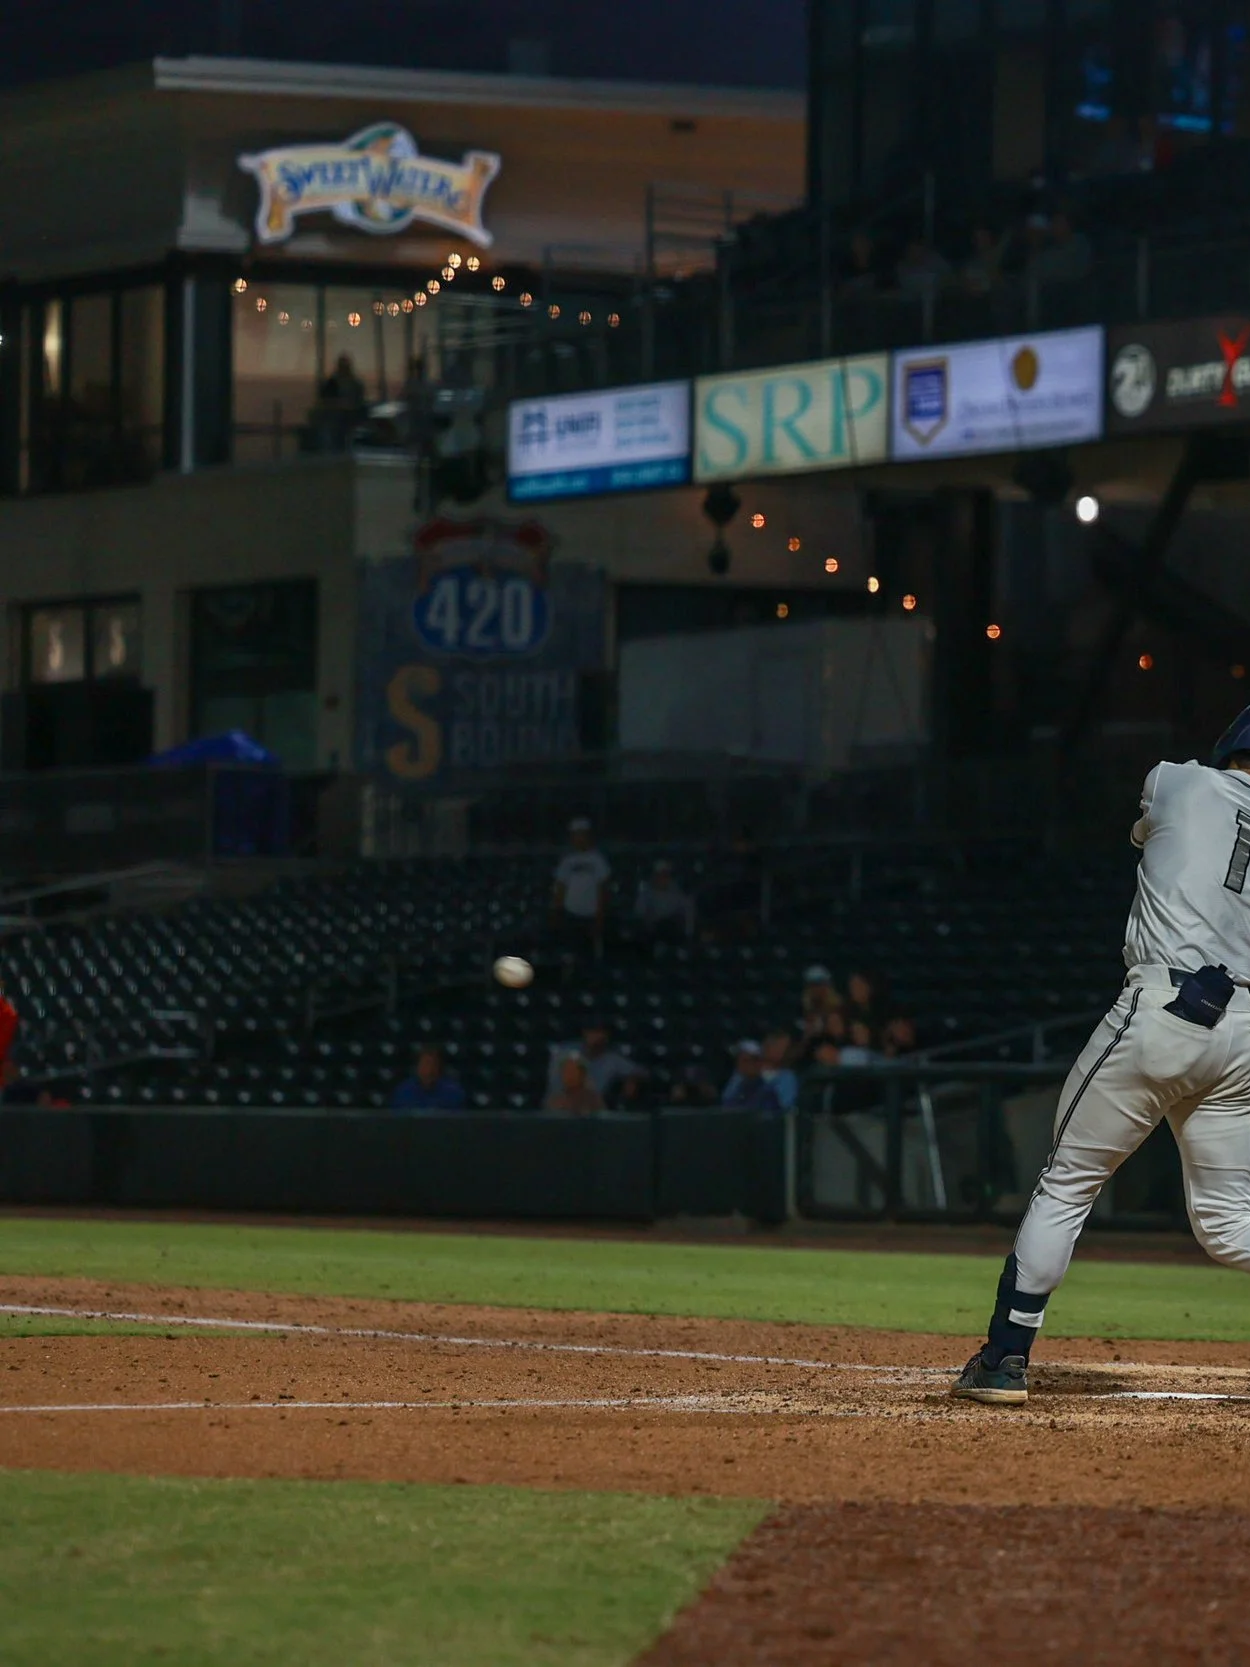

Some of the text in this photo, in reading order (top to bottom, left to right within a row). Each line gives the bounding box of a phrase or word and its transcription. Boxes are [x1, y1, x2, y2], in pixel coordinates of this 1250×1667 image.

[702, 364, 884, 472] SRP
[424, 573, 536, 649] 420
[454, 669, 577, 719] SOUTH
